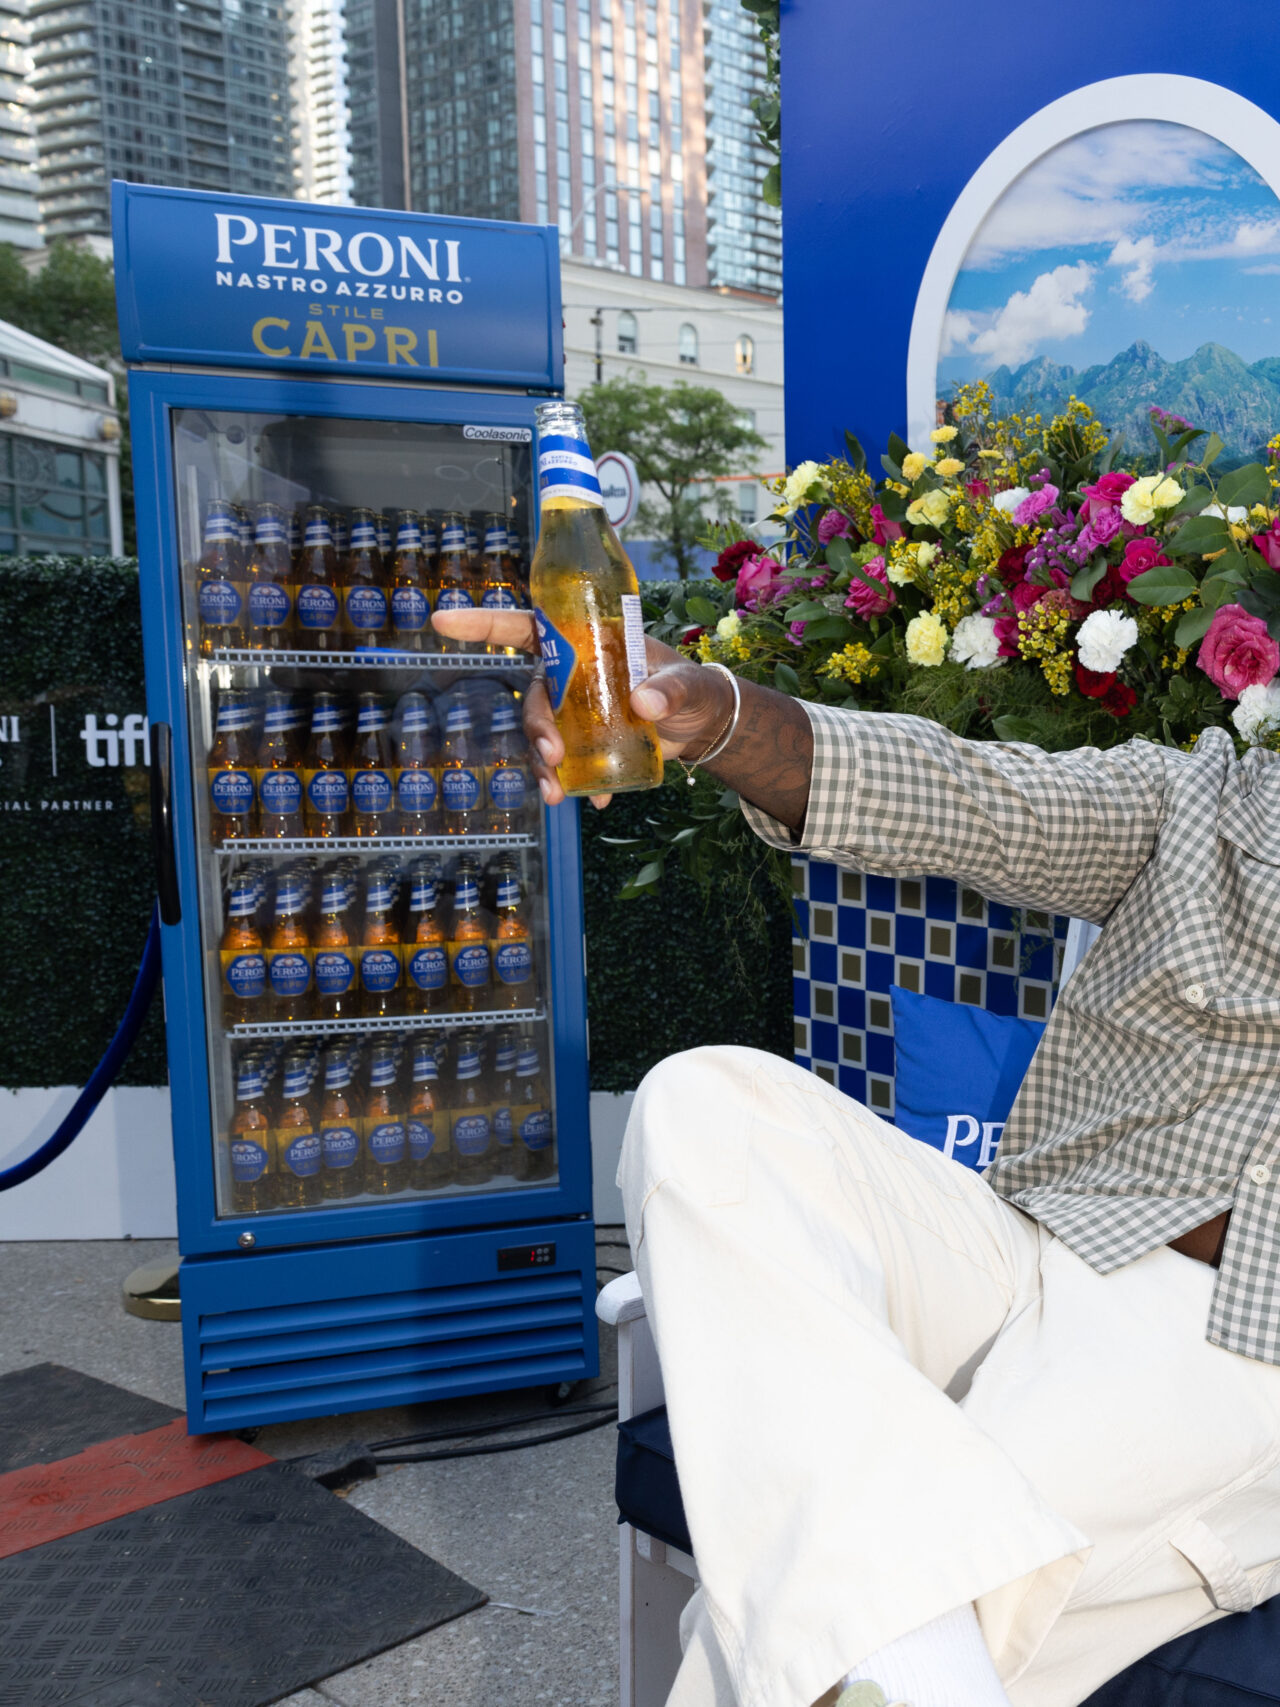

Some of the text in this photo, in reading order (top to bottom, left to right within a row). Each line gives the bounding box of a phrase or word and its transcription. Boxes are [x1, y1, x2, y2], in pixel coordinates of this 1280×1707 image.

[214, 213, 463, 282] PERONI
[217, 271, 463, 305] NASTRO AZZURRO
[309, 303, 384, 320] STILE
[252, 317, 438, 367] CAPRI
[465, 427, 530, 441] Coolasonic
[200, 594, 236, 603] PERONI
[251, 596, 286, 605] PERONI
[299, 599, 336, 608] PERONI
[350, 600, 385, 609] PERONI
[392, 601, 426, 610] PERONI
[214, 784, 252, 793] PERONI
[263, 784, 300, 793] PERONI
[354, 784, 389, 793] PERONI
[400, 783, 434, 792] PERONI
[443, 781, 476, 790] PERONI
[0, 801, 114, 811] IAL PARTNER
[363, 962, 396, 972] PERONI
[414, 960, 447, 970] PERON
[459, 957, 489, 967] PERON
[232, 967, 265, 977] PERON
[272, 966, 307, 976] PERONI
[316, 965, 350, 974] PERONI
[373, 1135, 404, 1145] PERON
[232, 1152, 262, 1162] ERONI
[290, 1147, 321, 1158] PERO
